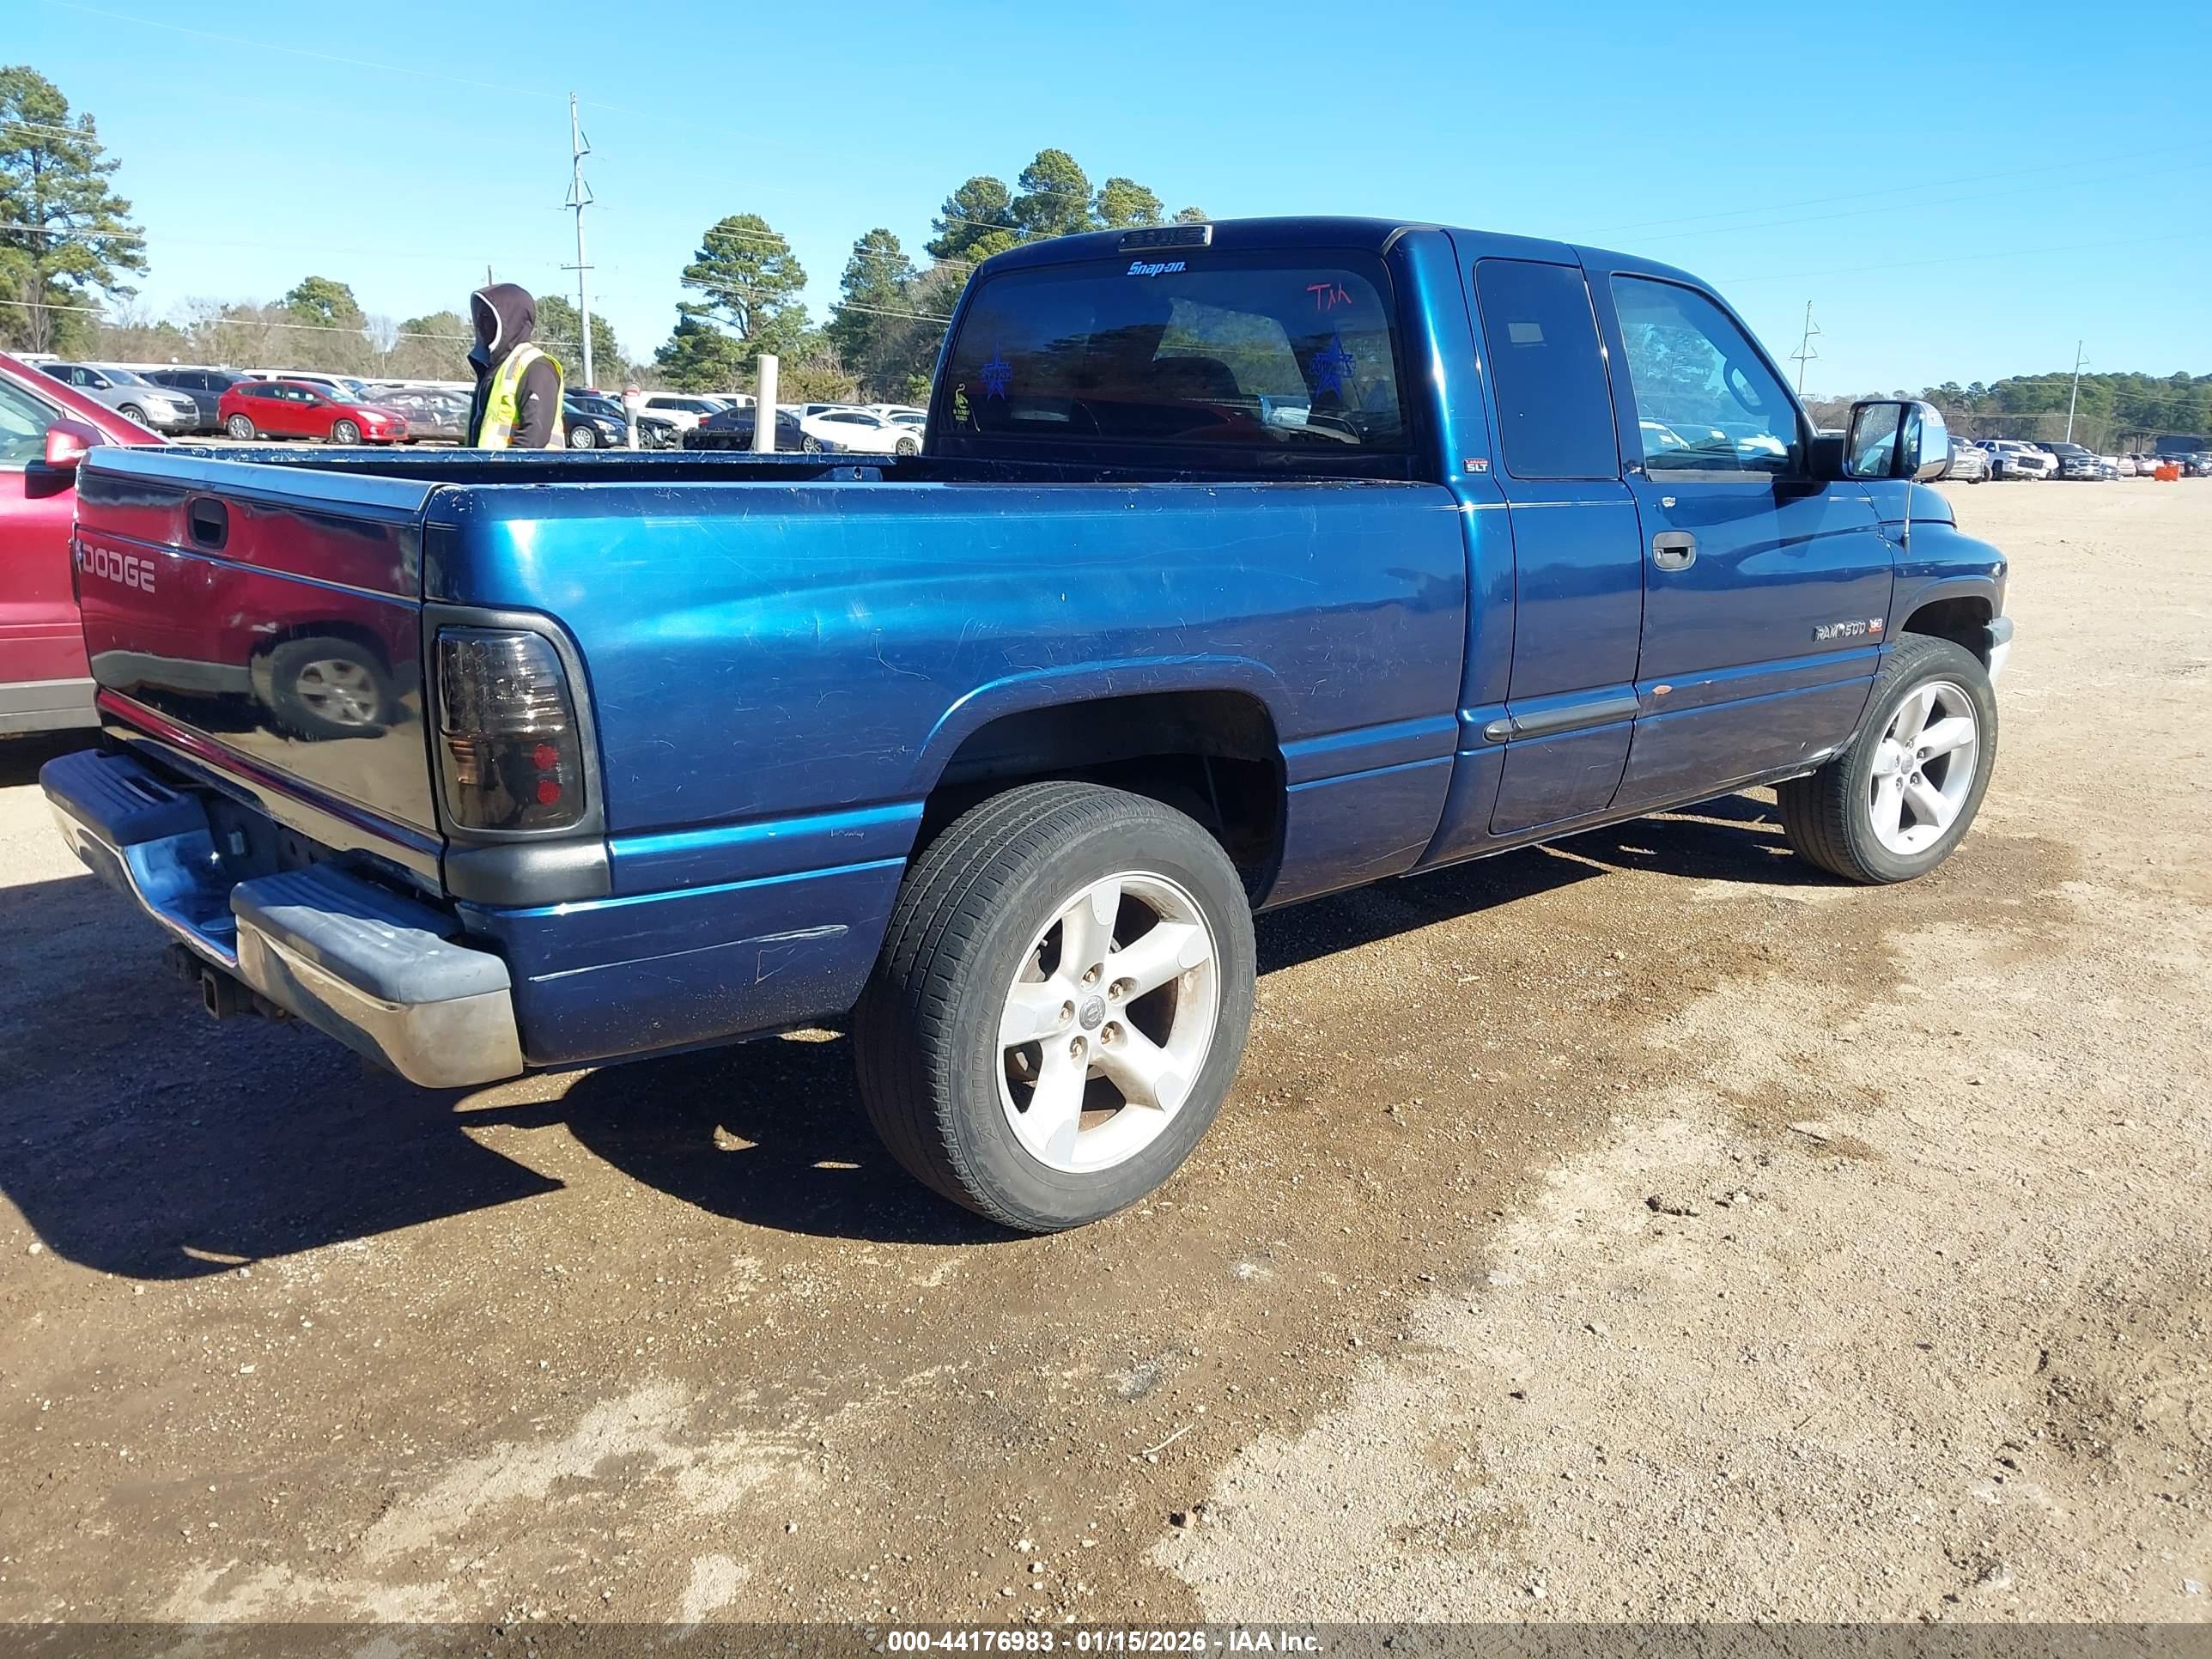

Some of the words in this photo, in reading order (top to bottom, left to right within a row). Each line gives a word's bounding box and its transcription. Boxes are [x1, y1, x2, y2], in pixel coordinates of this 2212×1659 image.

[1127, 261, 1185, 276] Snap-on
[1467, 464, 1488, 472] SLT
[82, 543, 155, 593] DODGE
